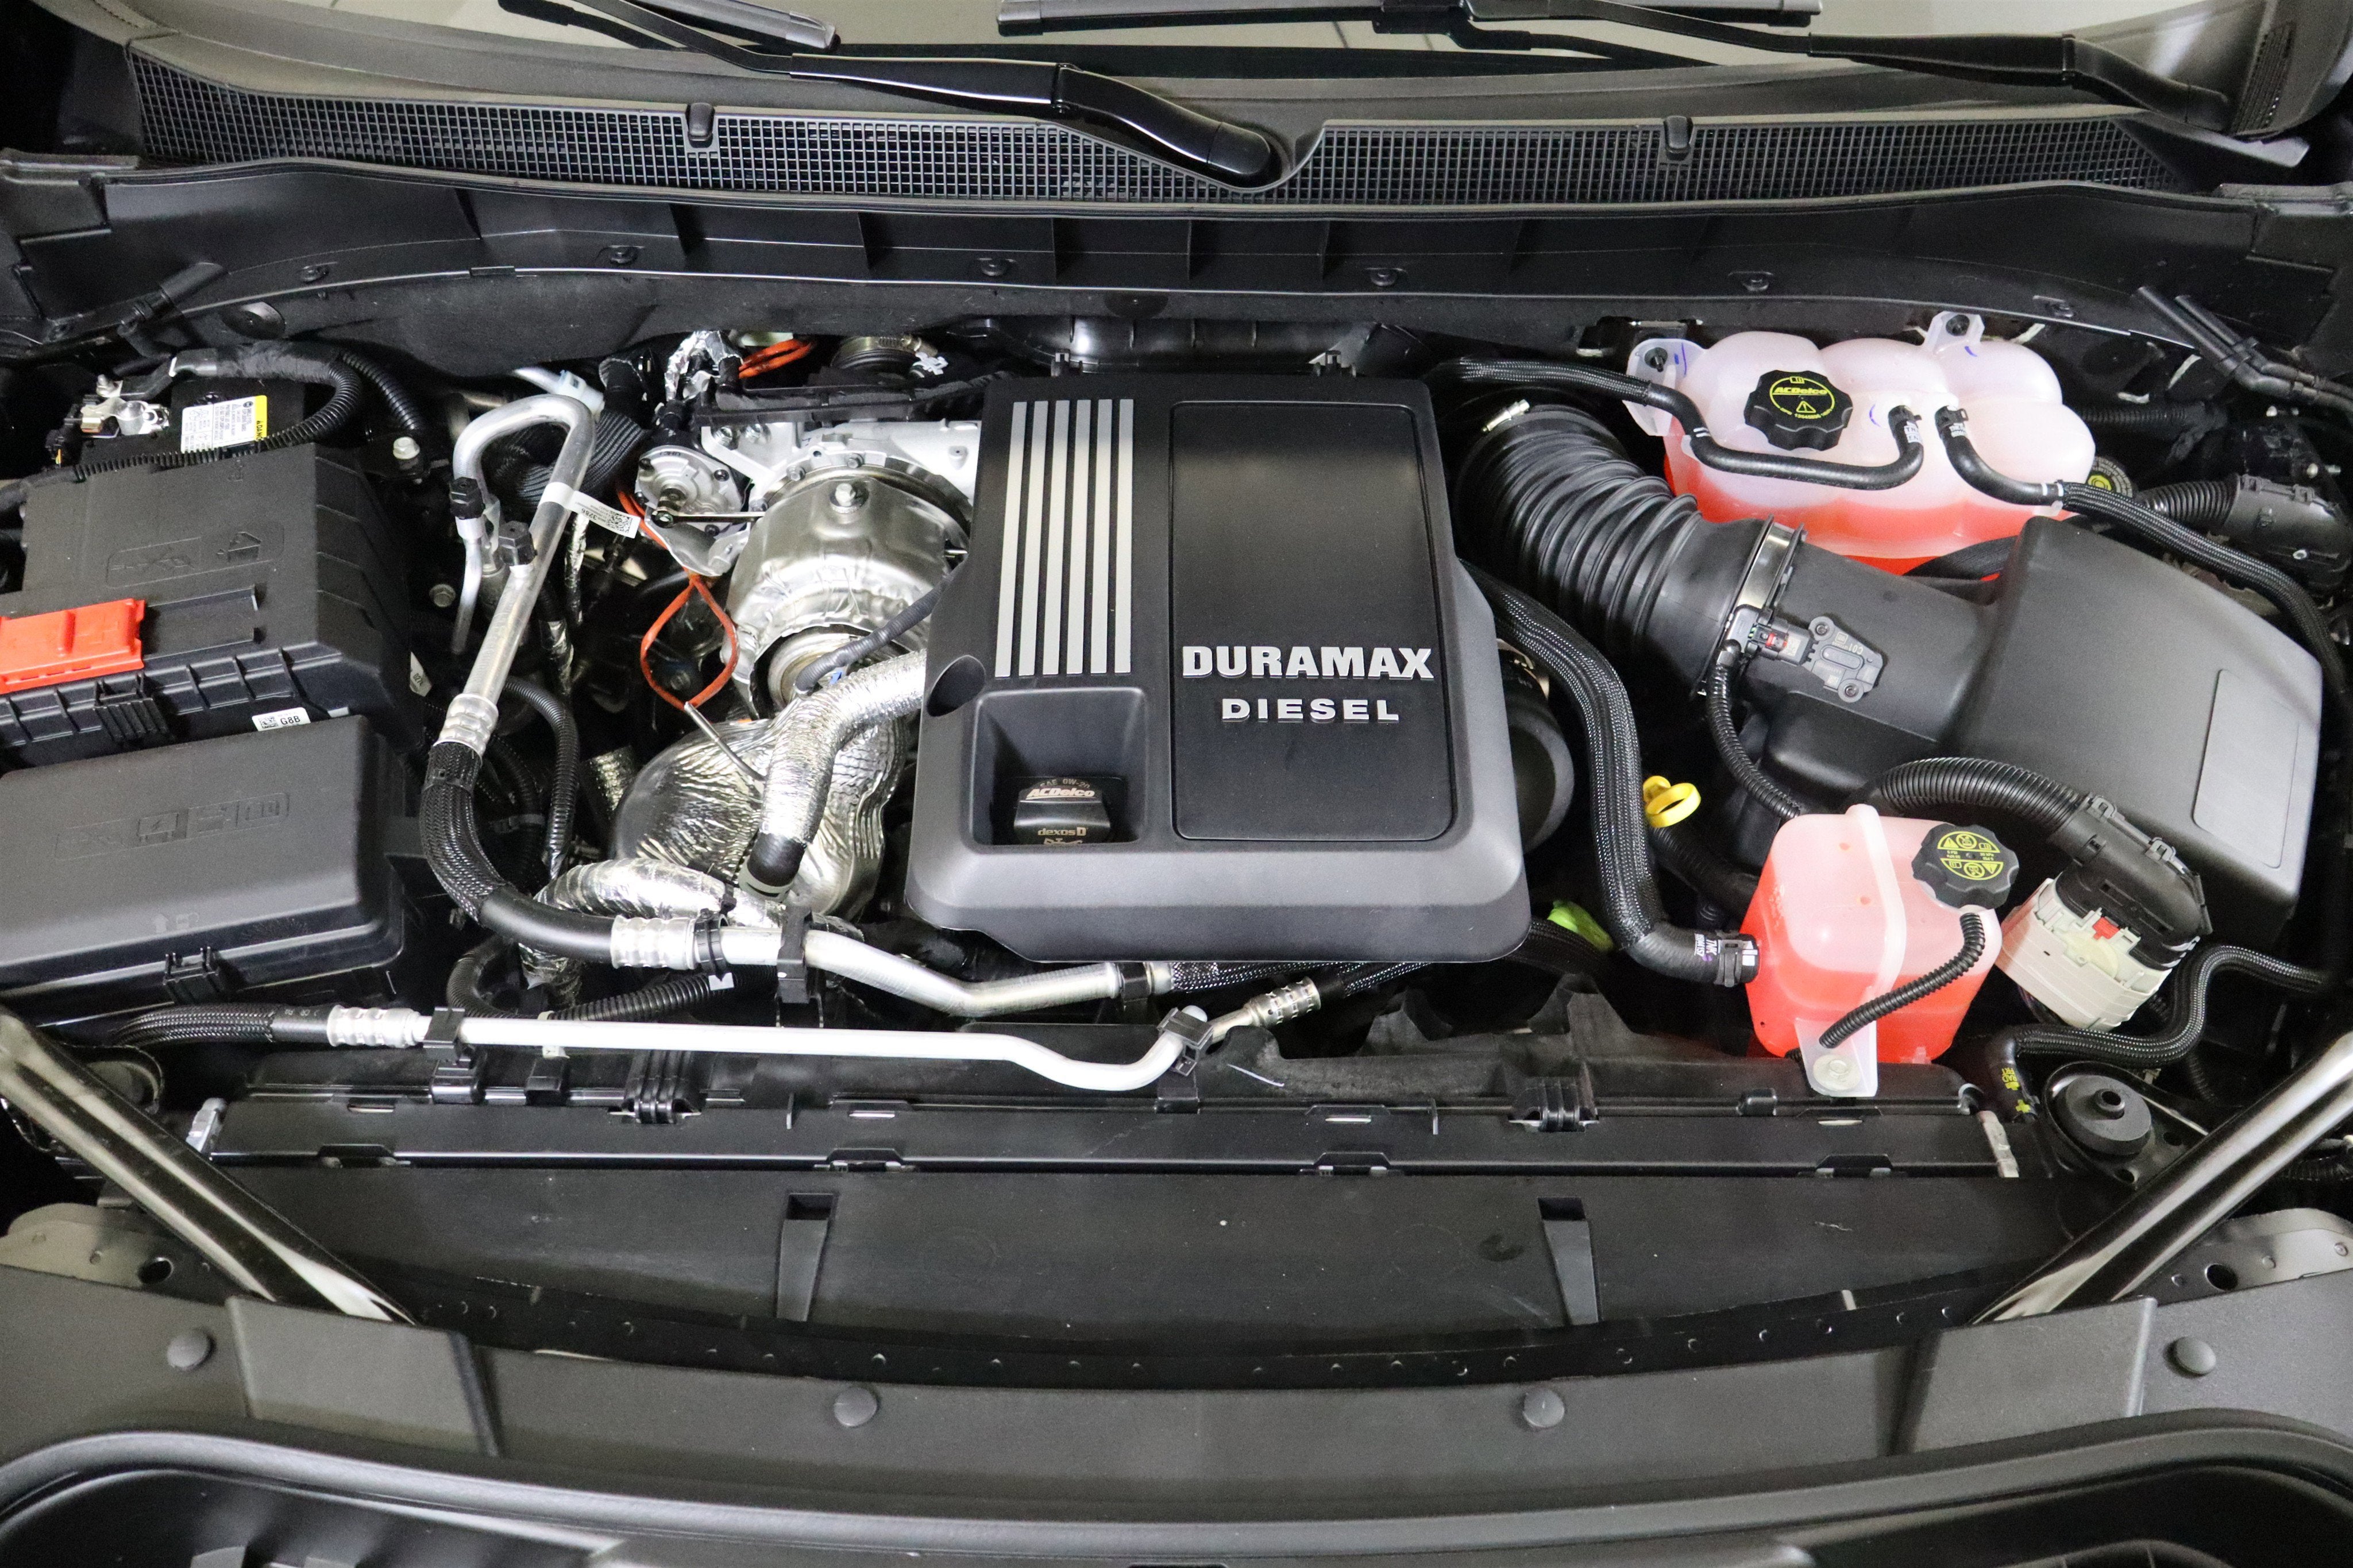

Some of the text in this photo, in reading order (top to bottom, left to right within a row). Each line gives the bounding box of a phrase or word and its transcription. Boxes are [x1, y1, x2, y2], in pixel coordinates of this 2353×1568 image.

[1774, 387, 1827, 395] ACDelco
[581, 508, 597, 520] 3286
[1182, 646, 1434, 680] DURAMAX
[1222, 698, 1399, 723] DIESEL
[280, 716, 300, 725] G8B
[1063, 778, 1090, 789] 0W-20
[1026, 788, 1096, 797] ACDelco
